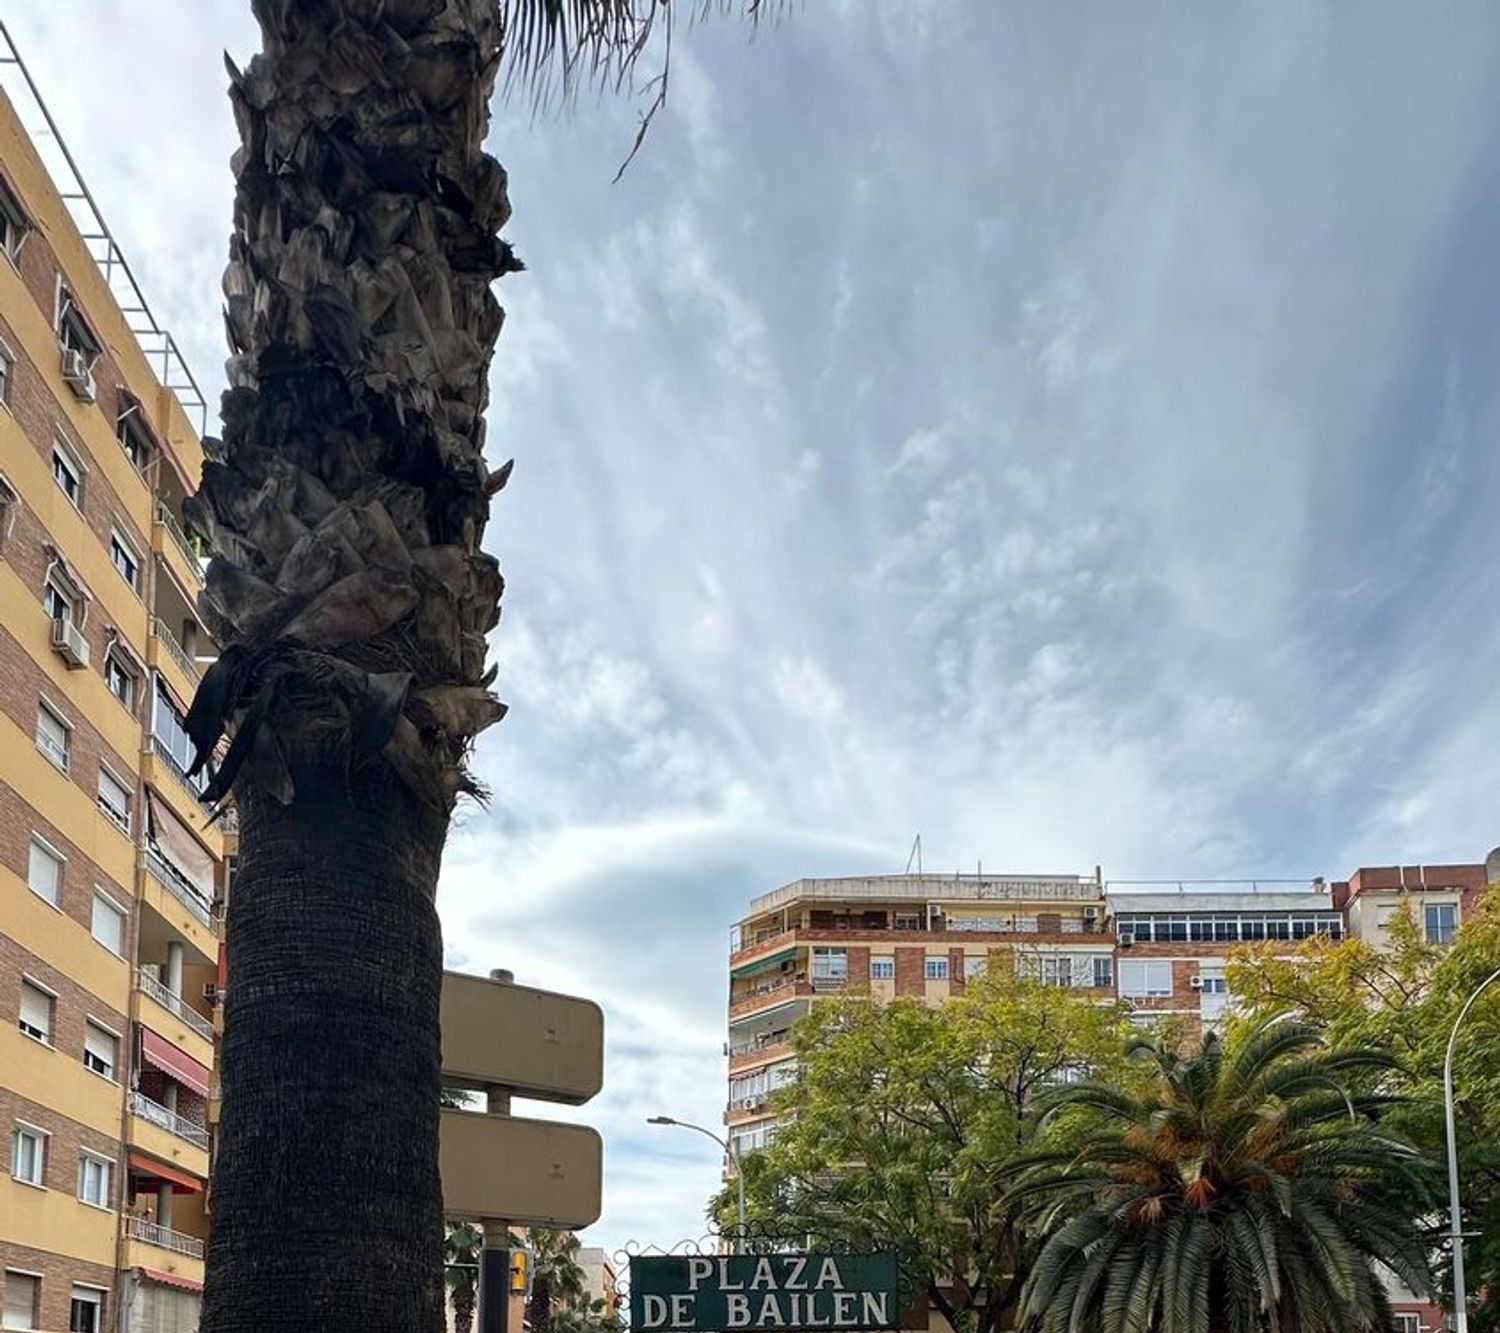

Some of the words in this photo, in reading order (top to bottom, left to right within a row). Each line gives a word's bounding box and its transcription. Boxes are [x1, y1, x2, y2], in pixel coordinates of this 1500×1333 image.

[688, 1258, 844, 1290] PLAZA
[643, 1295, 696, 1327] DE
[726, 1292, 888, 1326] BAILEN
